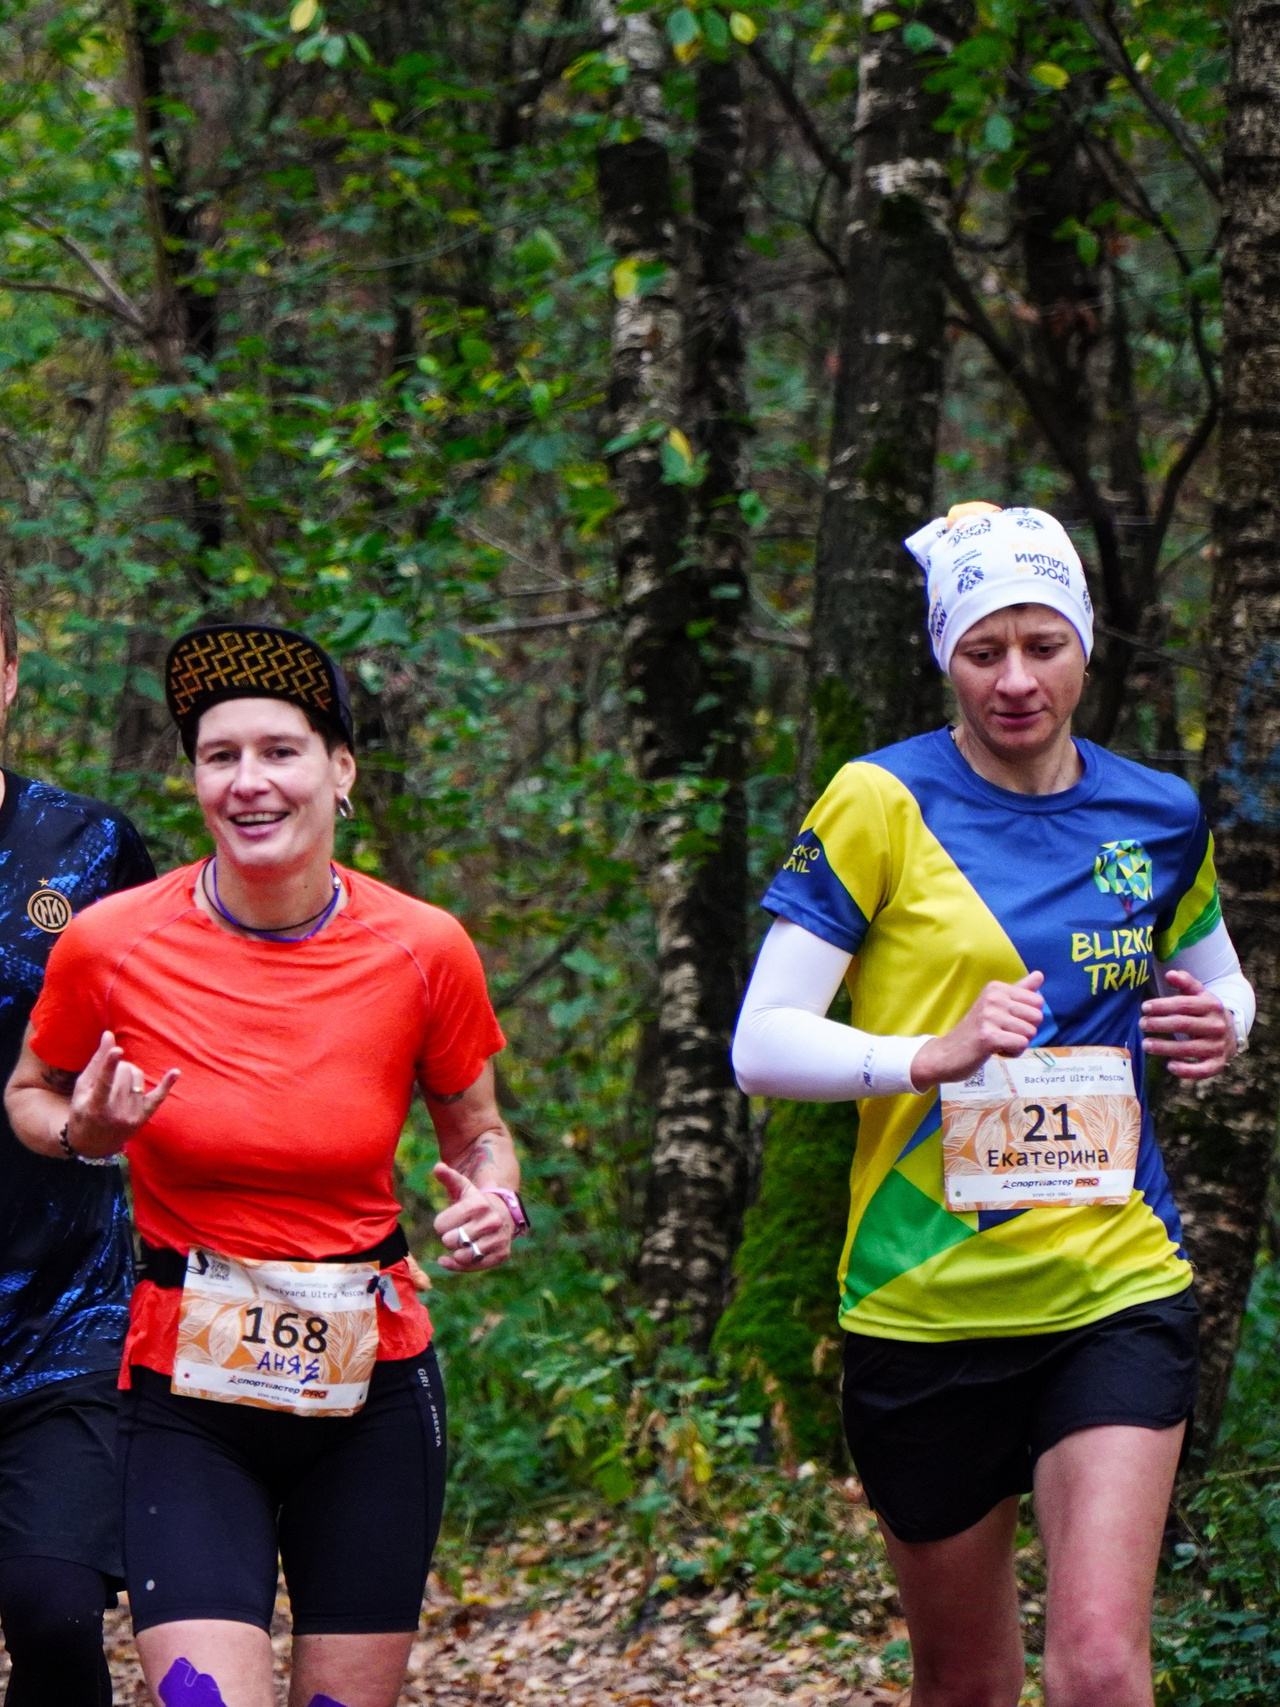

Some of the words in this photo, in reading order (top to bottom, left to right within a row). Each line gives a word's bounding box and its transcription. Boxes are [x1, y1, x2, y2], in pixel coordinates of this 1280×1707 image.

[1083, 959, 1150, 995] TRAIL
[1024, 1075, 1065, 1084] Backyard
[1070, 1074, 1095, 1082] Ultra
[1023, 1103, 1077, 1142] 21
[987, 1149, 1109, 1169] Екатерина
[1075, 1177, 1099, 1187] PRO
[311, 1291, 338, 1299] Ultra
[241, 1306, 329, 1354] 168
[301, 1388, 327, 1399] PRO
